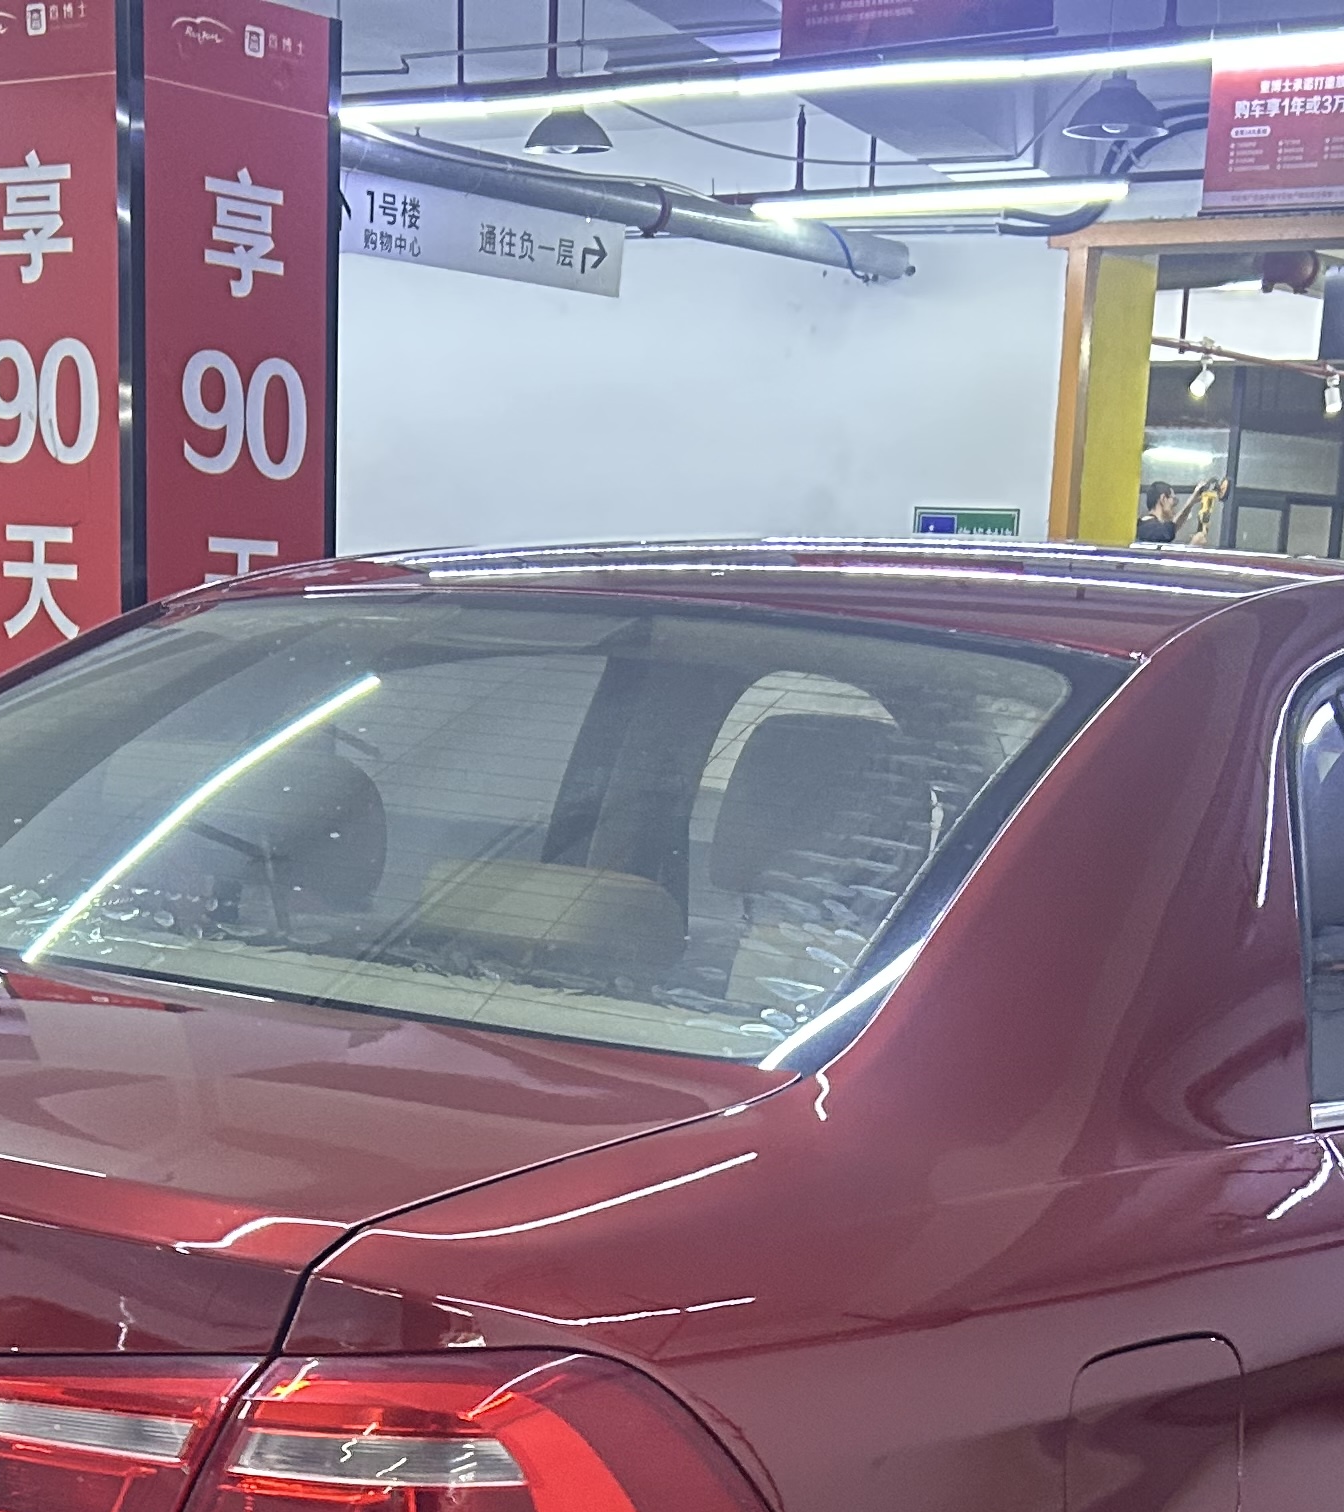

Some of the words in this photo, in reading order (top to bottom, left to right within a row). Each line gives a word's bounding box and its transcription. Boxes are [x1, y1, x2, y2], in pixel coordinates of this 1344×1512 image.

[365, 190, 422, 231] 1号楼
[363, 228, 422, 258] 购物中心
[478, 222, 575, 269] 通往负一层
